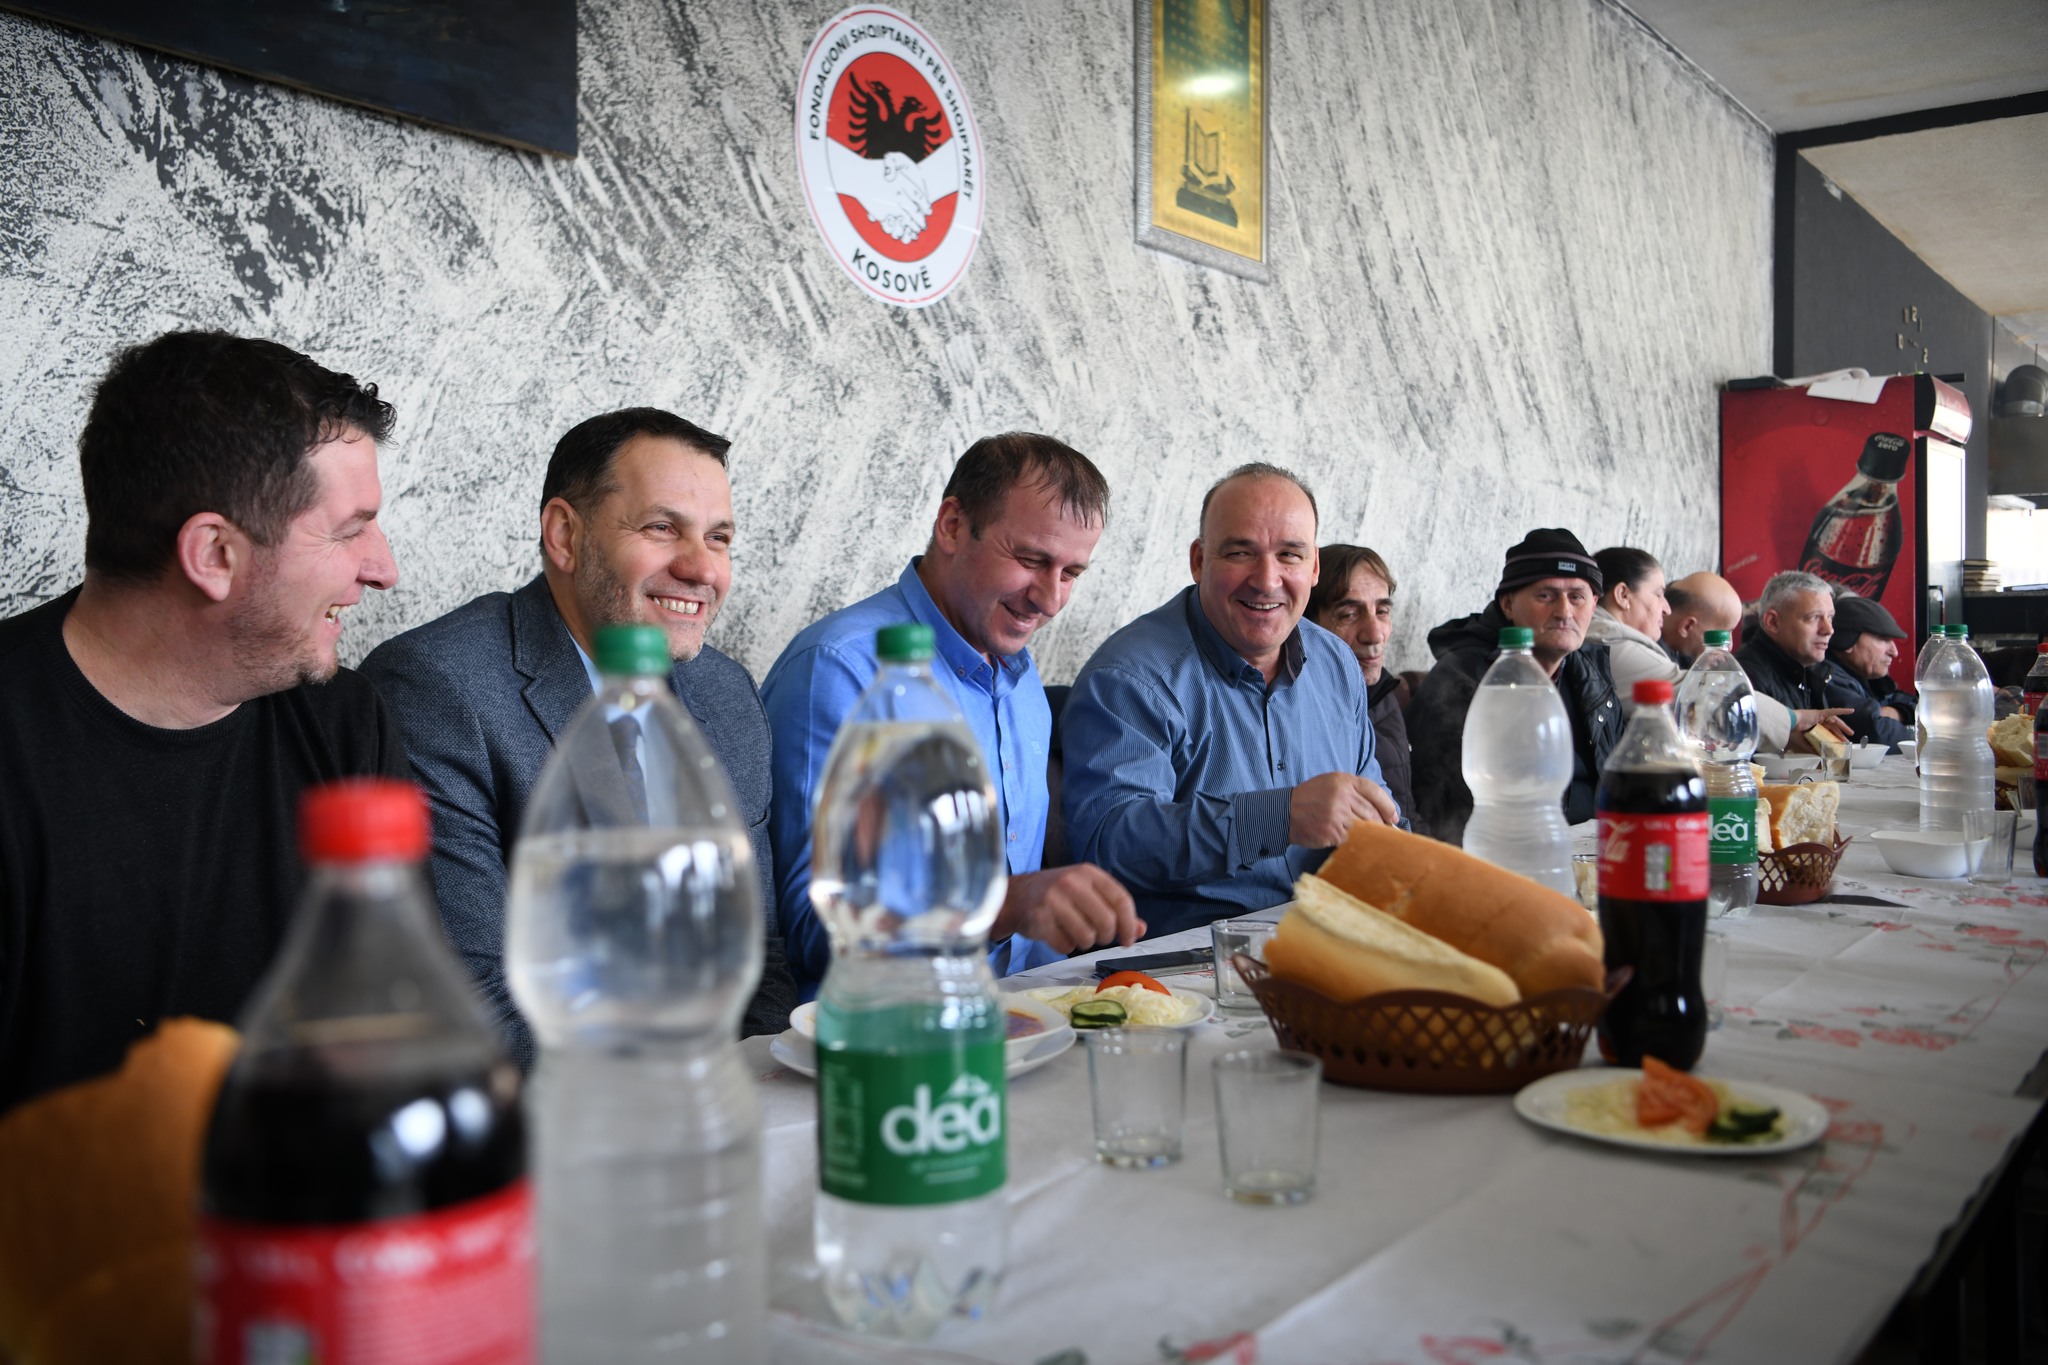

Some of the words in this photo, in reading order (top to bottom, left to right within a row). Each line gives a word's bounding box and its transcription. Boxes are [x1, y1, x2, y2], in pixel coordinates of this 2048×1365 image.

[809, 34, 851, 141] FONDACIONI
[852, 247, 932, 292] KOSOVË
[879, 1082, 1000, 1156] dea
